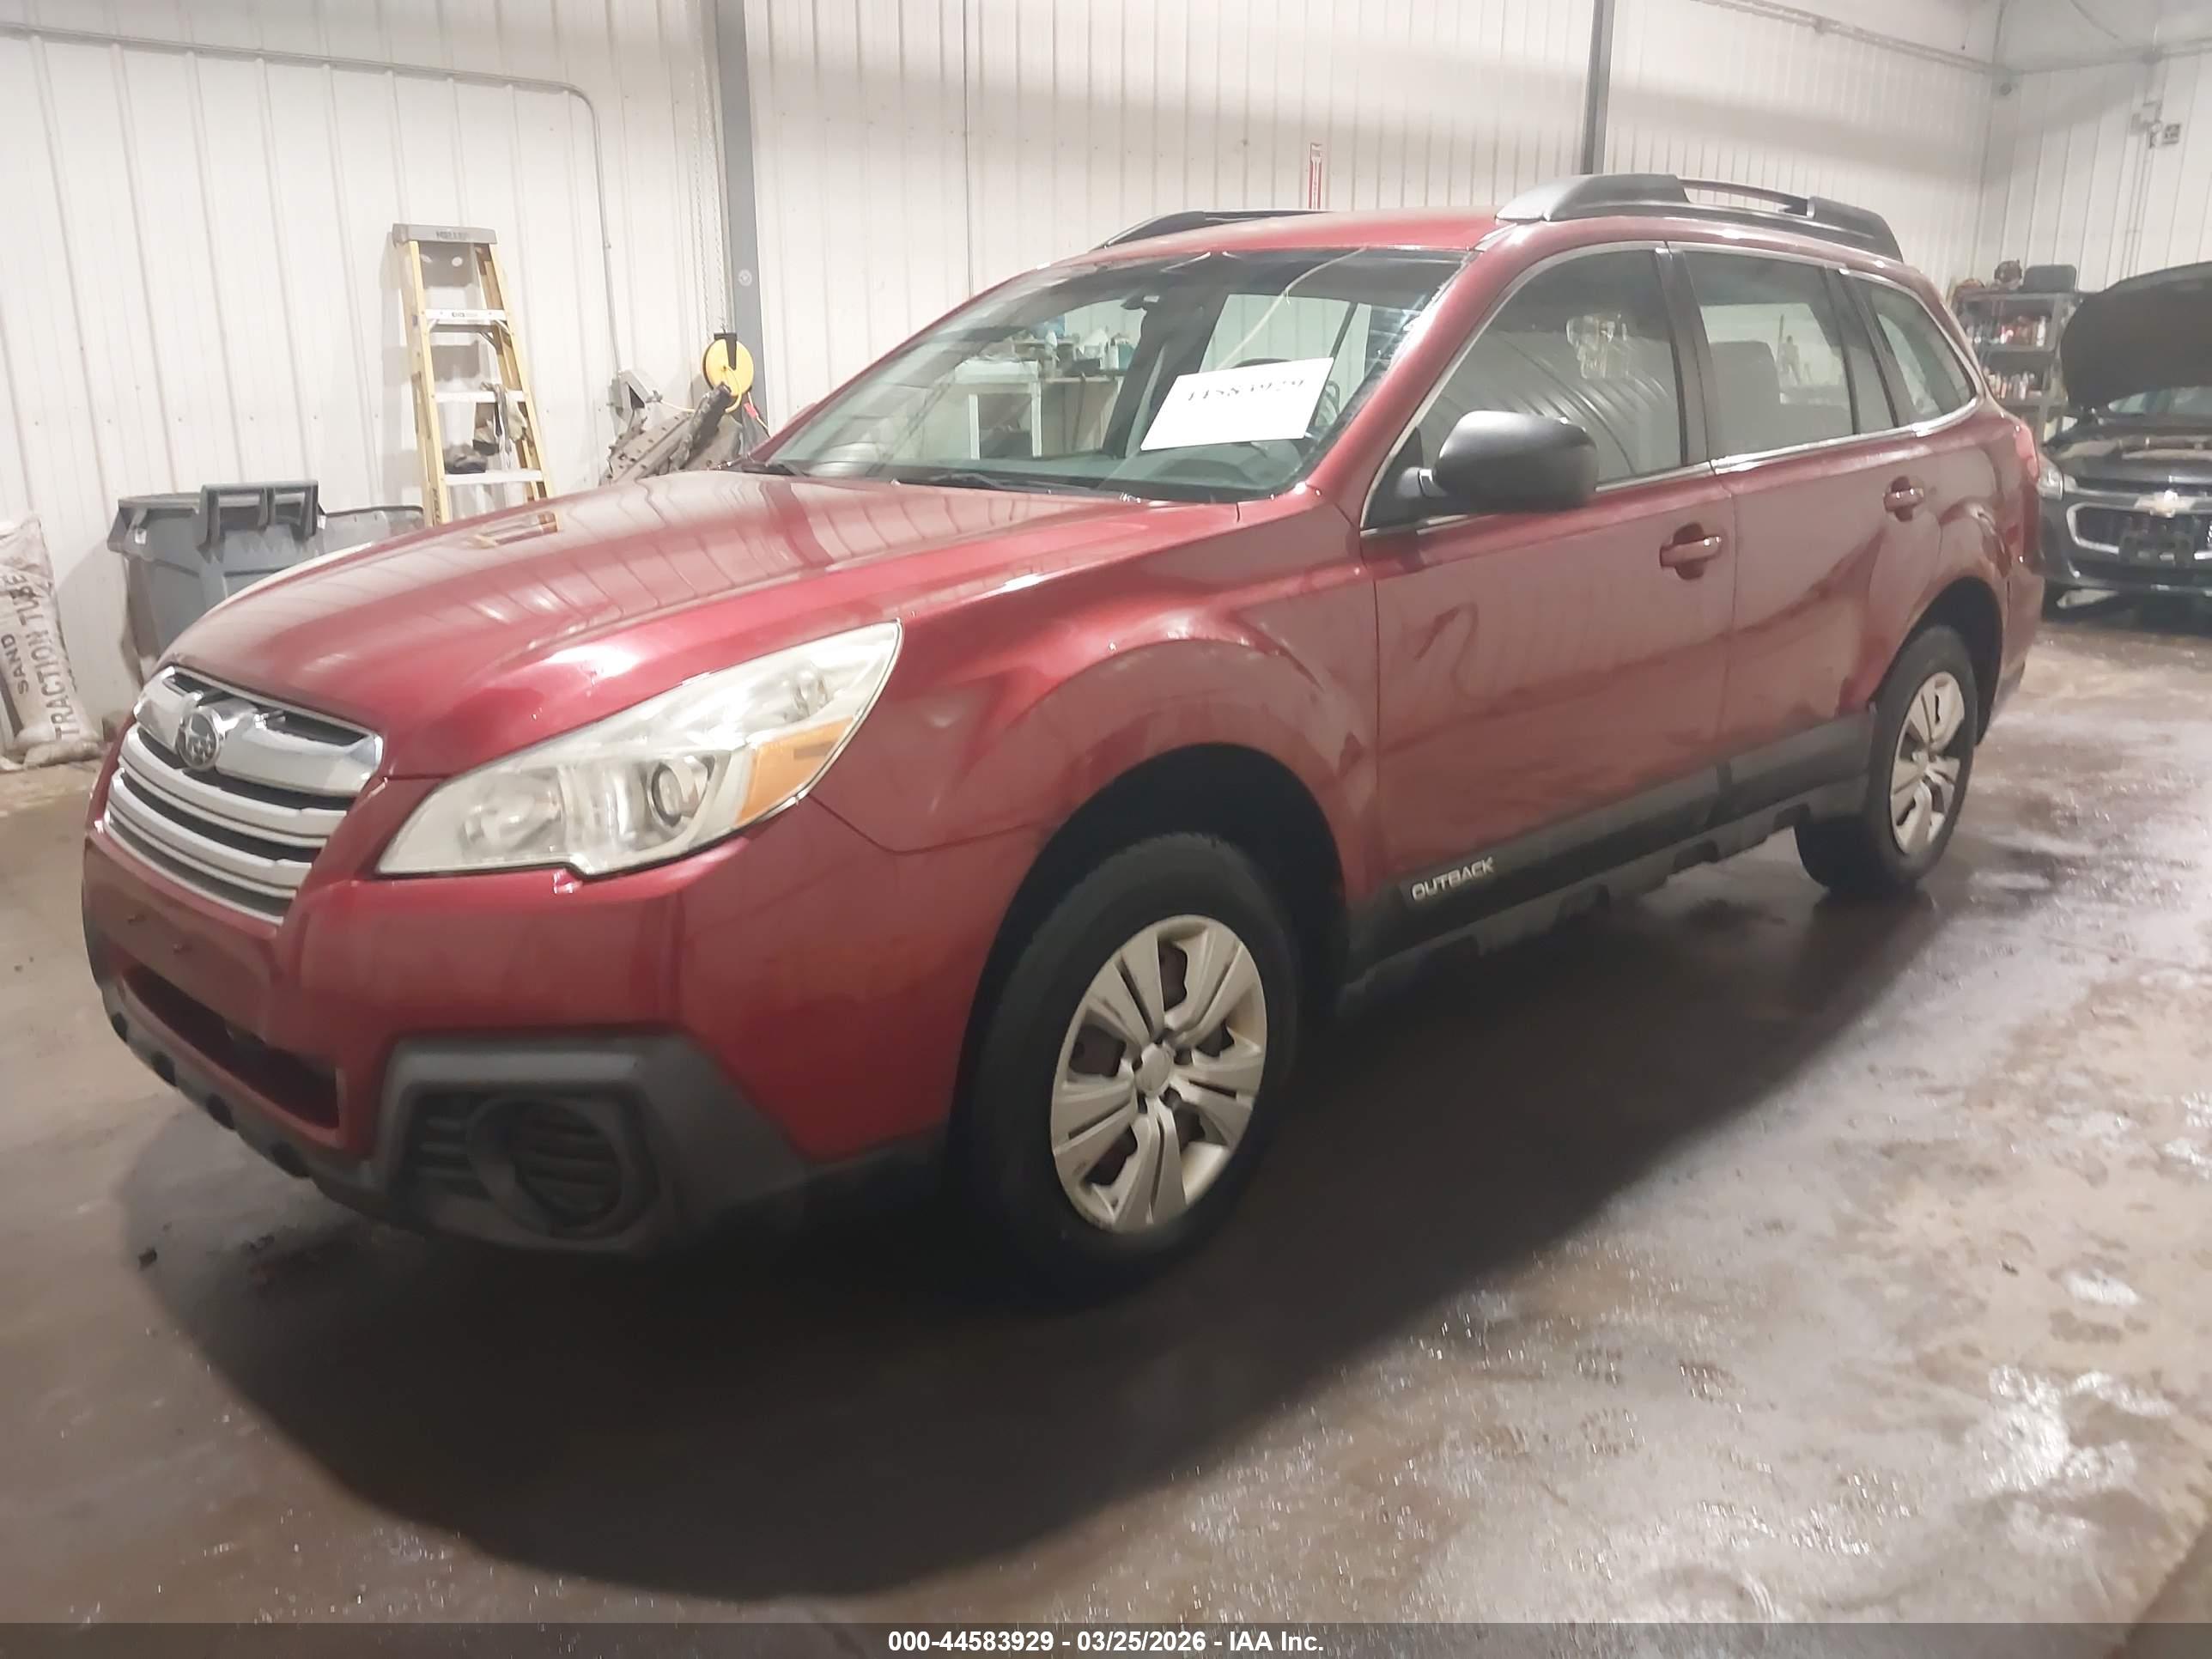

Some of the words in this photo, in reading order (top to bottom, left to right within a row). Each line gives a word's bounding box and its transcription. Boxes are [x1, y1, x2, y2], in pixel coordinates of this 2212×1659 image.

[1, 634, 28, 695] SAND
[27, 629, 80, 740] TRACTION
[1411, 856, 1495, 902] OUTBACK
